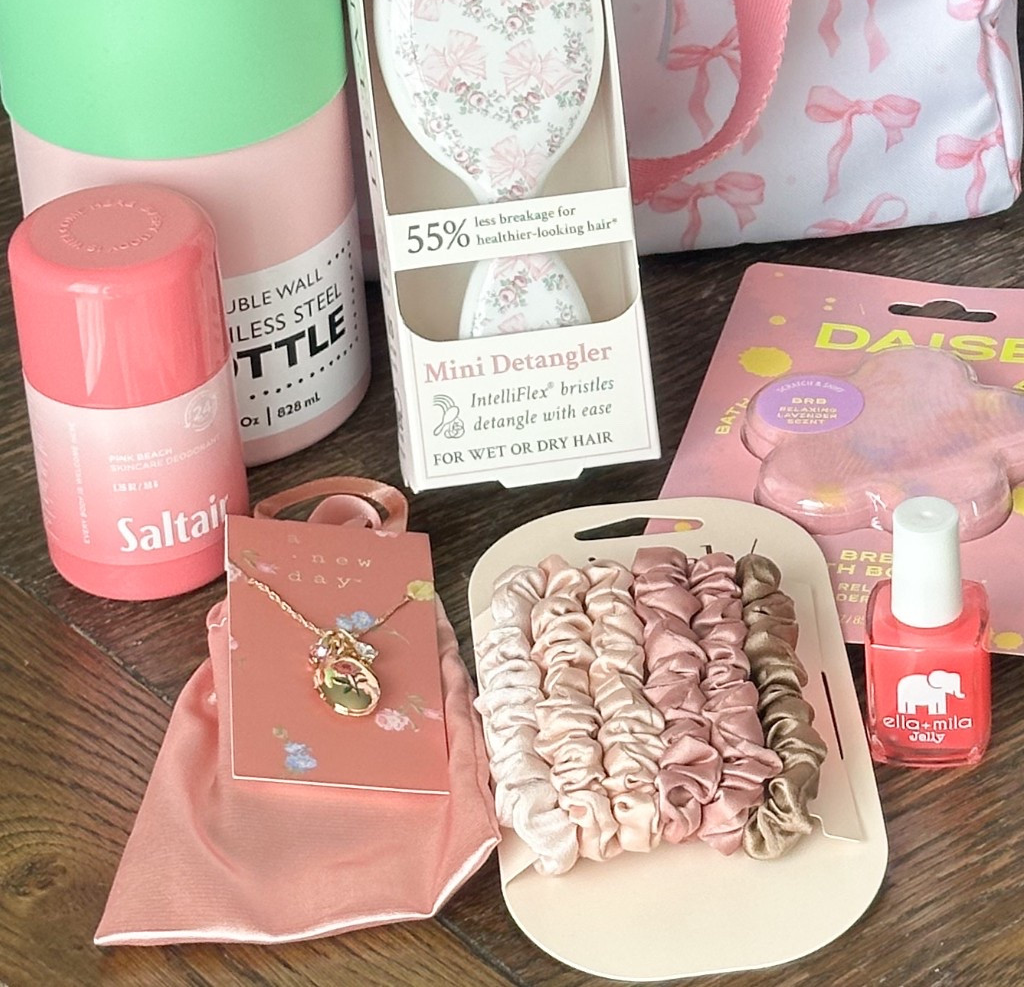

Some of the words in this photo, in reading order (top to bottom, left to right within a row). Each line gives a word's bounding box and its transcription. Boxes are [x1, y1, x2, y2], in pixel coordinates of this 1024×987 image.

[407, 217, 471, 255] 55%
[474, 215, 497, 228] less
[499, 209, 556, 225] breakage
[557, 205, 577, 218] for
[476, 224, 585, 246] healthier-looking
[275, 268, 324, 300] WALL
[293, 283, 342, 323] STEEL
[233, 303, 346, 380] TTLE
[424, 360, 484, 385] Mini
[490, 342, 613, 376] Detangler
[560, 377, 615, 397] bristles
[277, 401, 302, 418] 828
[473, 409, 538, 433] detangle
[543, 403, 577, 422] with
[581, 402, 613, 416] ease
[777, 412, 838, 420] LAVENDER
[136, 448, 173, 461] BEACH
[433, 451, 465, 467] FOR
[467, 446, 507, 461] WET
[510, 441, 533, 455] OR
[537, 437, 570, 452] DRY
[573, 431, 614, 448] HAIR
[116, 494, 229, 552] Saltair
[908, 731, 946, 744] Jelly
